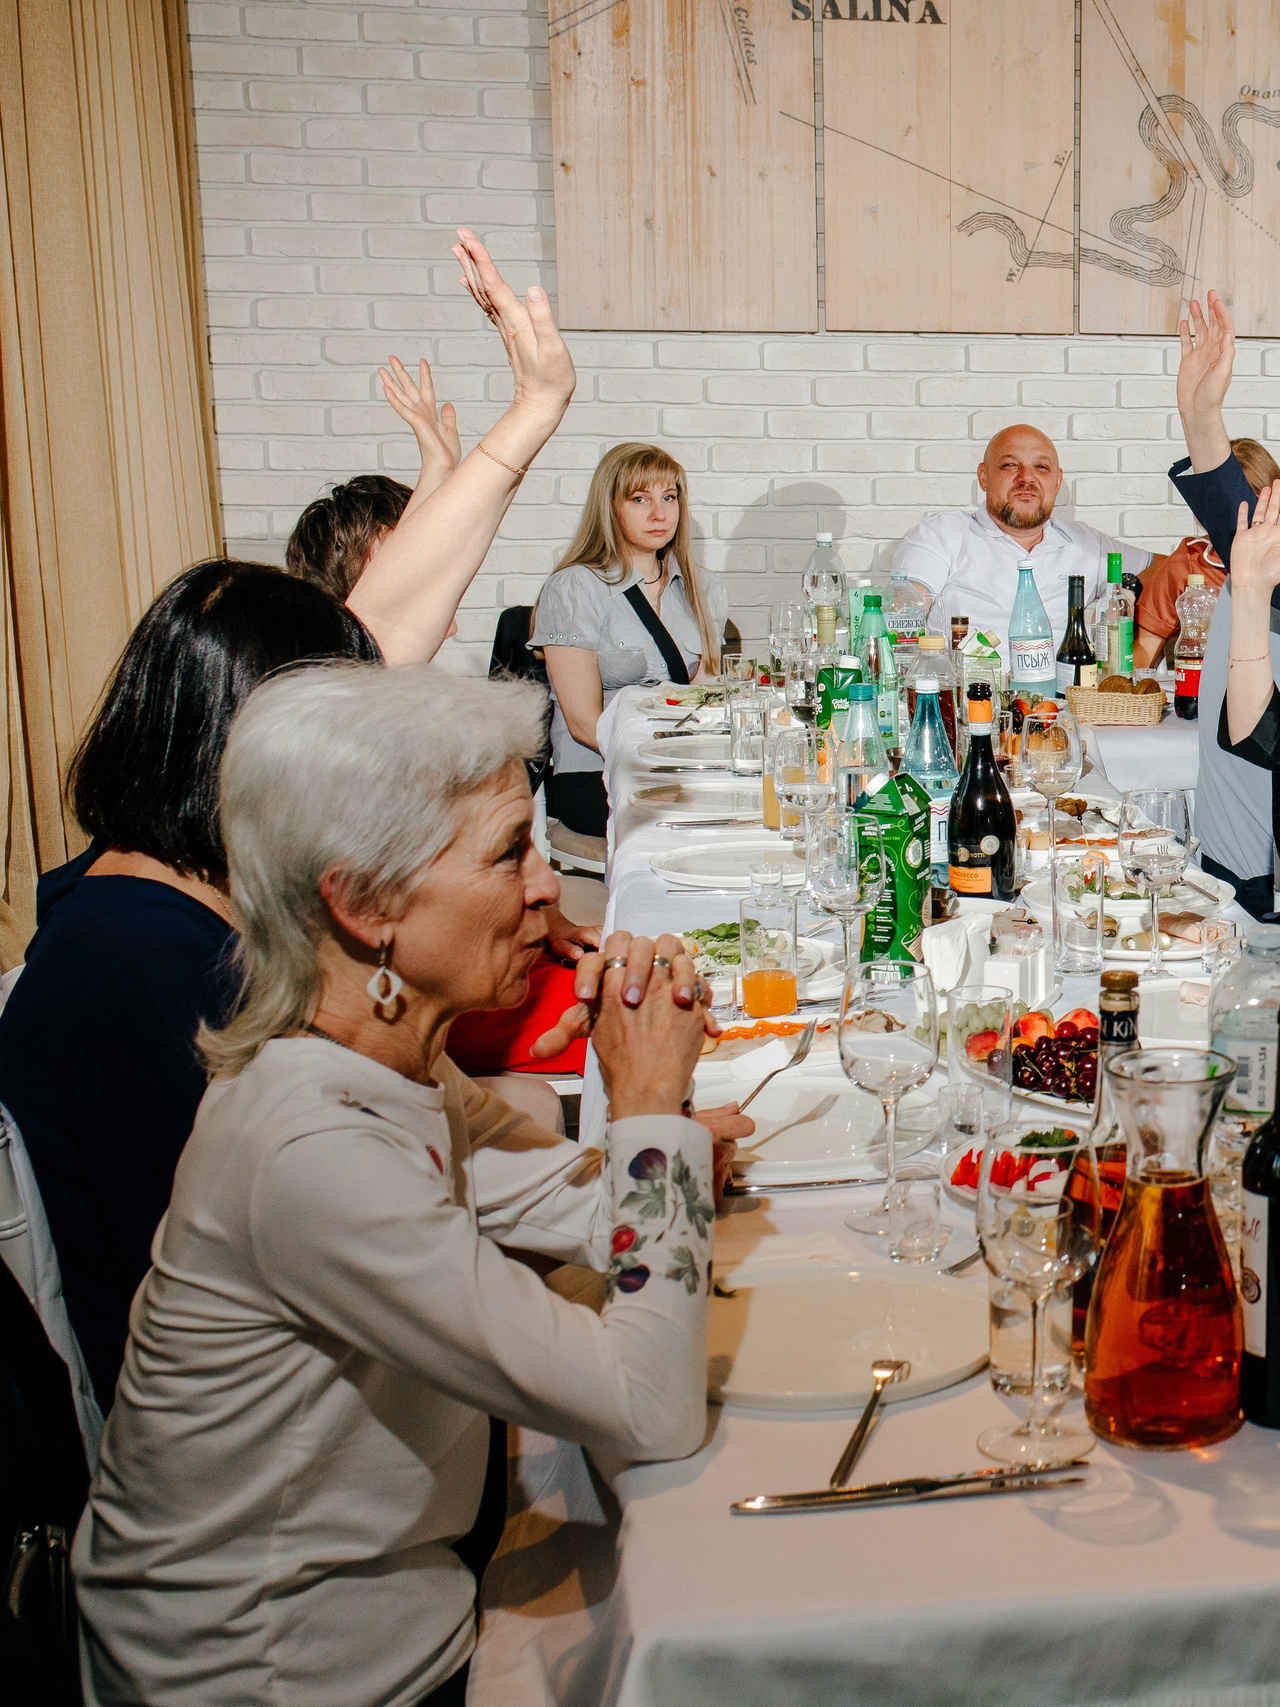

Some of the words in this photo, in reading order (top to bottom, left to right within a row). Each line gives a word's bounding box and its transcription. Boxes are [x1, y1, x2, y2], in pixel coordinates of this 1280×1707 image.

[791, 0, 947, 25] SALINA
[733, 6, 757, 66] Geddes
[1052, 149, 1069, 169] E.
[1005, 267, 1021, 283] W.
[1017, 652, 1051, 669] ПСЫЖ
[952, 870, 979, 879] PROSECCO
